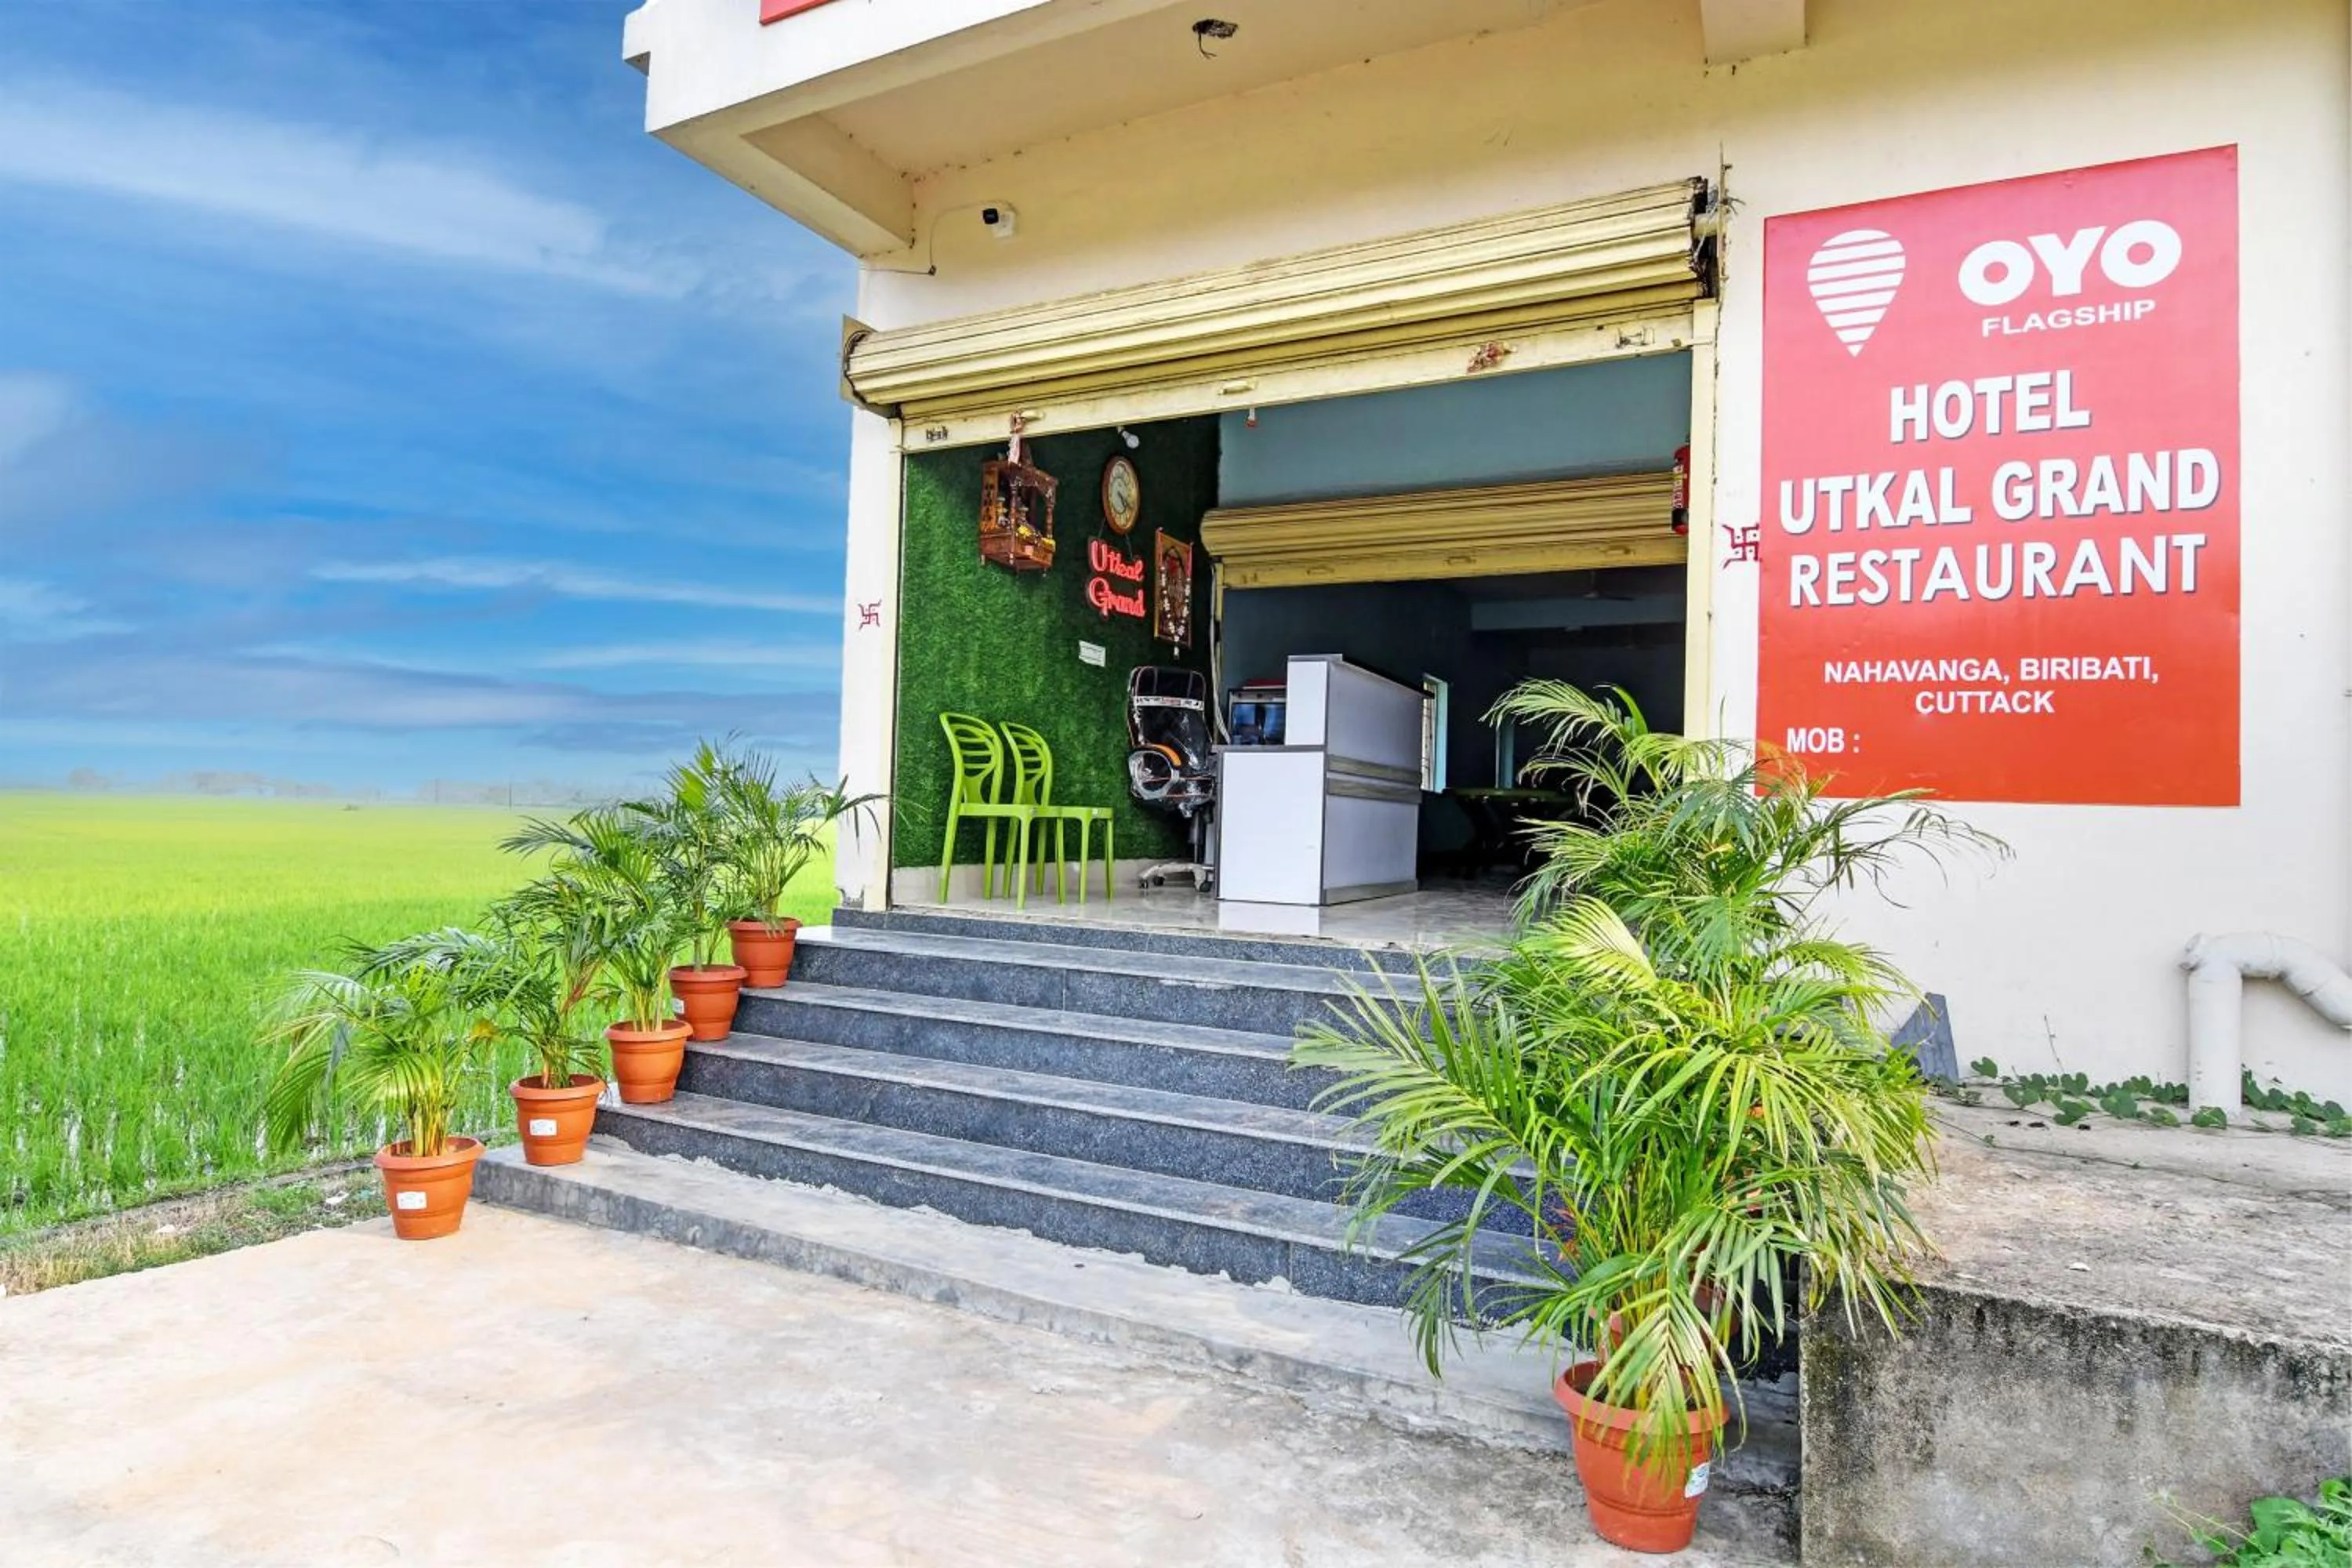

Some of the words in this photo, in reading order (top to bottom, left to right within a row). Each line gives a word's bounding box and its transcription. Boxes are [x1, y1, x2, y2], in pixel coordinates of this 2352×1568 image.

[1958, 220, 2183, 306] OYO
[1981, 299, 2157, 338] FLAGSHIP
[1889, 369, 2092, 445] HOTEL
[1780, 466, 1973, 535] UTKAL
[1991, 448, 2222, 521] GRAND
[1788, 533, 2206, 607] RESTAURANT
[1088, 576, 1145, 617] Grand
[1824, 657, 2011, 685] NAHAVANGA,
[2019, 655, 2159, 684] BIRIBATI,
[1915, 690, 2055, 716] CUTTACK
[1786, 727, 1845, 753] MOB
